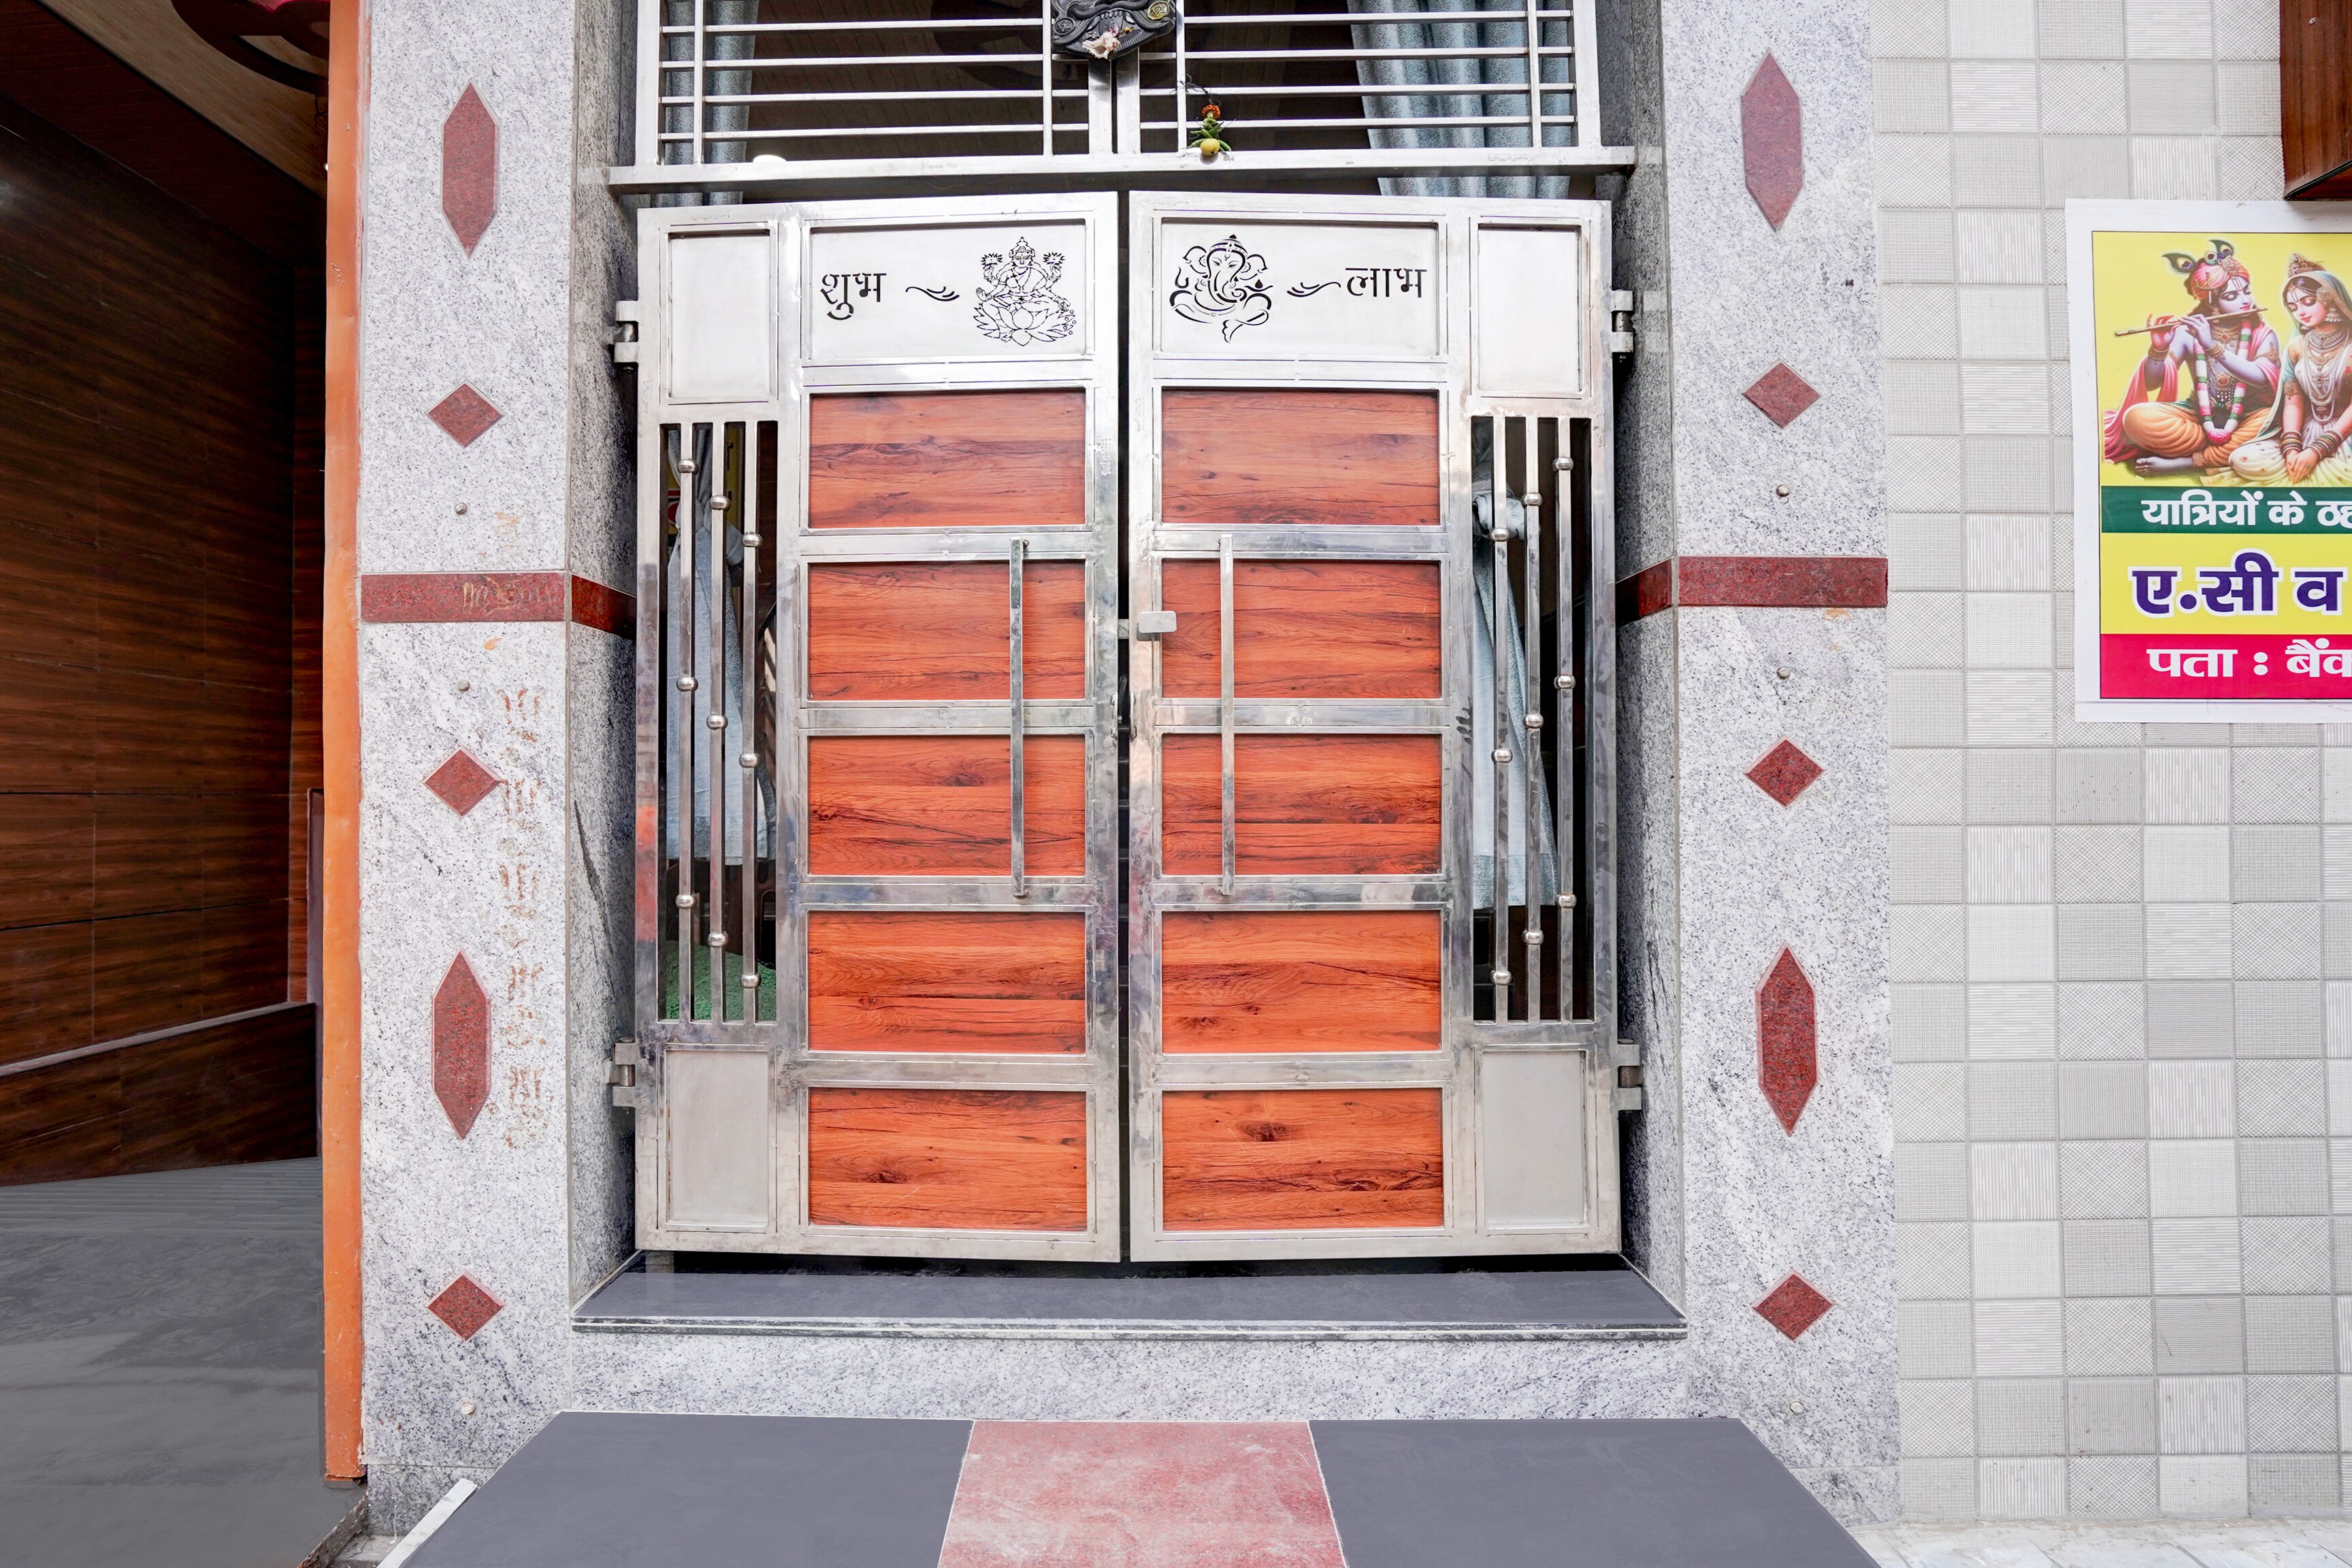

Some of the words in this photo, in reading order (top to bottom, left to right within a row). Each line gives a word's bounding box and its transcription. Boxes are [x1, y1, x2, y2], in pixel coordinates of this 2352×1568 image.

[819, 272, 887, 321] शुभ
[1345, 267, 1428, 298] लाभ
[2141, 489, 2264, 525] यात्रियों
[2267, 490, 2308, 525] के
[2131, 551, 2281, 615] ए.सी
[2293, 570, 2345, 612] व
[2146, 649, 2238, 677] पता
